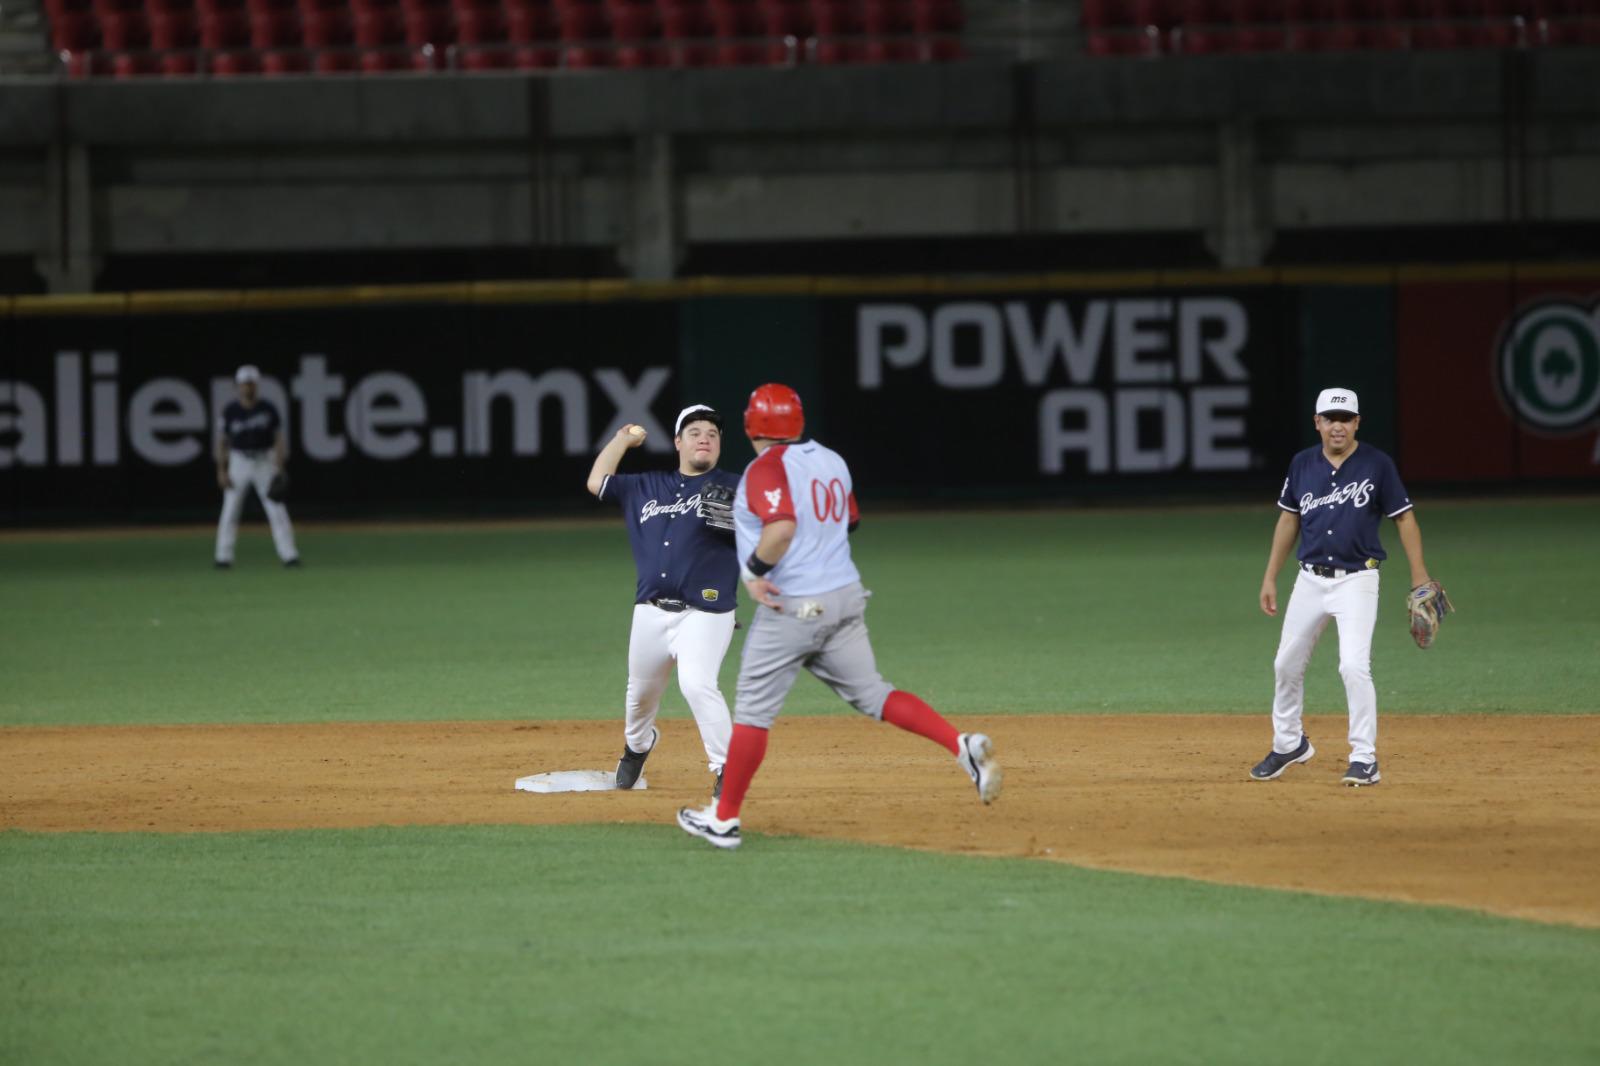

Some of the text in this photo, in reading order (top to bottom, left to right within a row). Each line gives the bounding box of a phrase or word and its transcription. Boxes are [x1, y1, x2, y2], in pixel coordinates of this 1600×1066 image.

[858, 297, 1249, 389] POWER
[1038, 387, 1251, 474] ADE
[811, 478, 846, 523] 00
